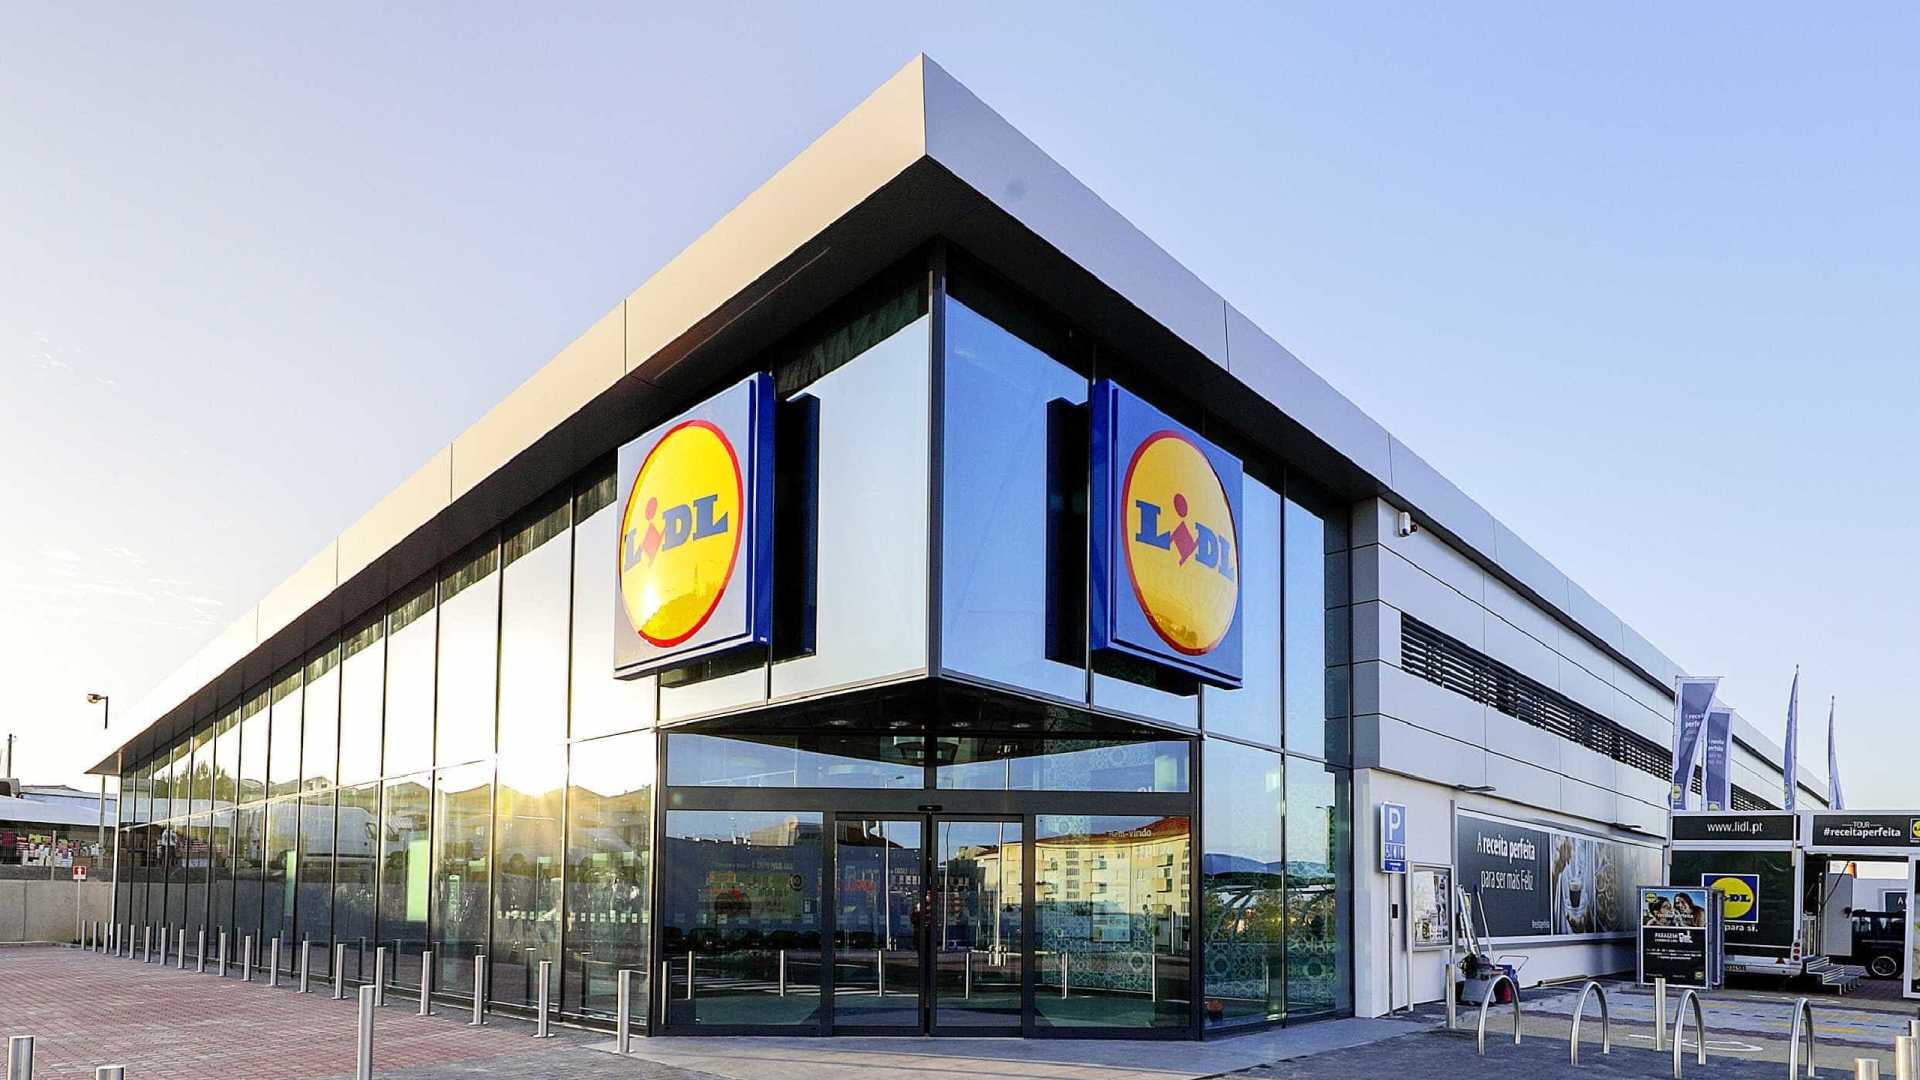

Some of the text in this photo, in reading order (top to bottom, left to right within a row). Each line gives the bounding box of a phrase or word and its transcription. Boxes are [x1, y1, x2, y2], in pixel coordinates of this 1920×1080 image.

[1388, 807, 1400, 840] P
[1707, 821, 1763, 834] www.lidl.pt
[1823, 826, 1901, 838] #receitaperfeita
[1477, 831, 1536, 864] A receita perfeita
[1481, 870, 1495, 894] para
[1496, 871, 1506, 889] ser
[1507, 869, 1520, 890] mais
[1724, 924, 1745, 932] para
